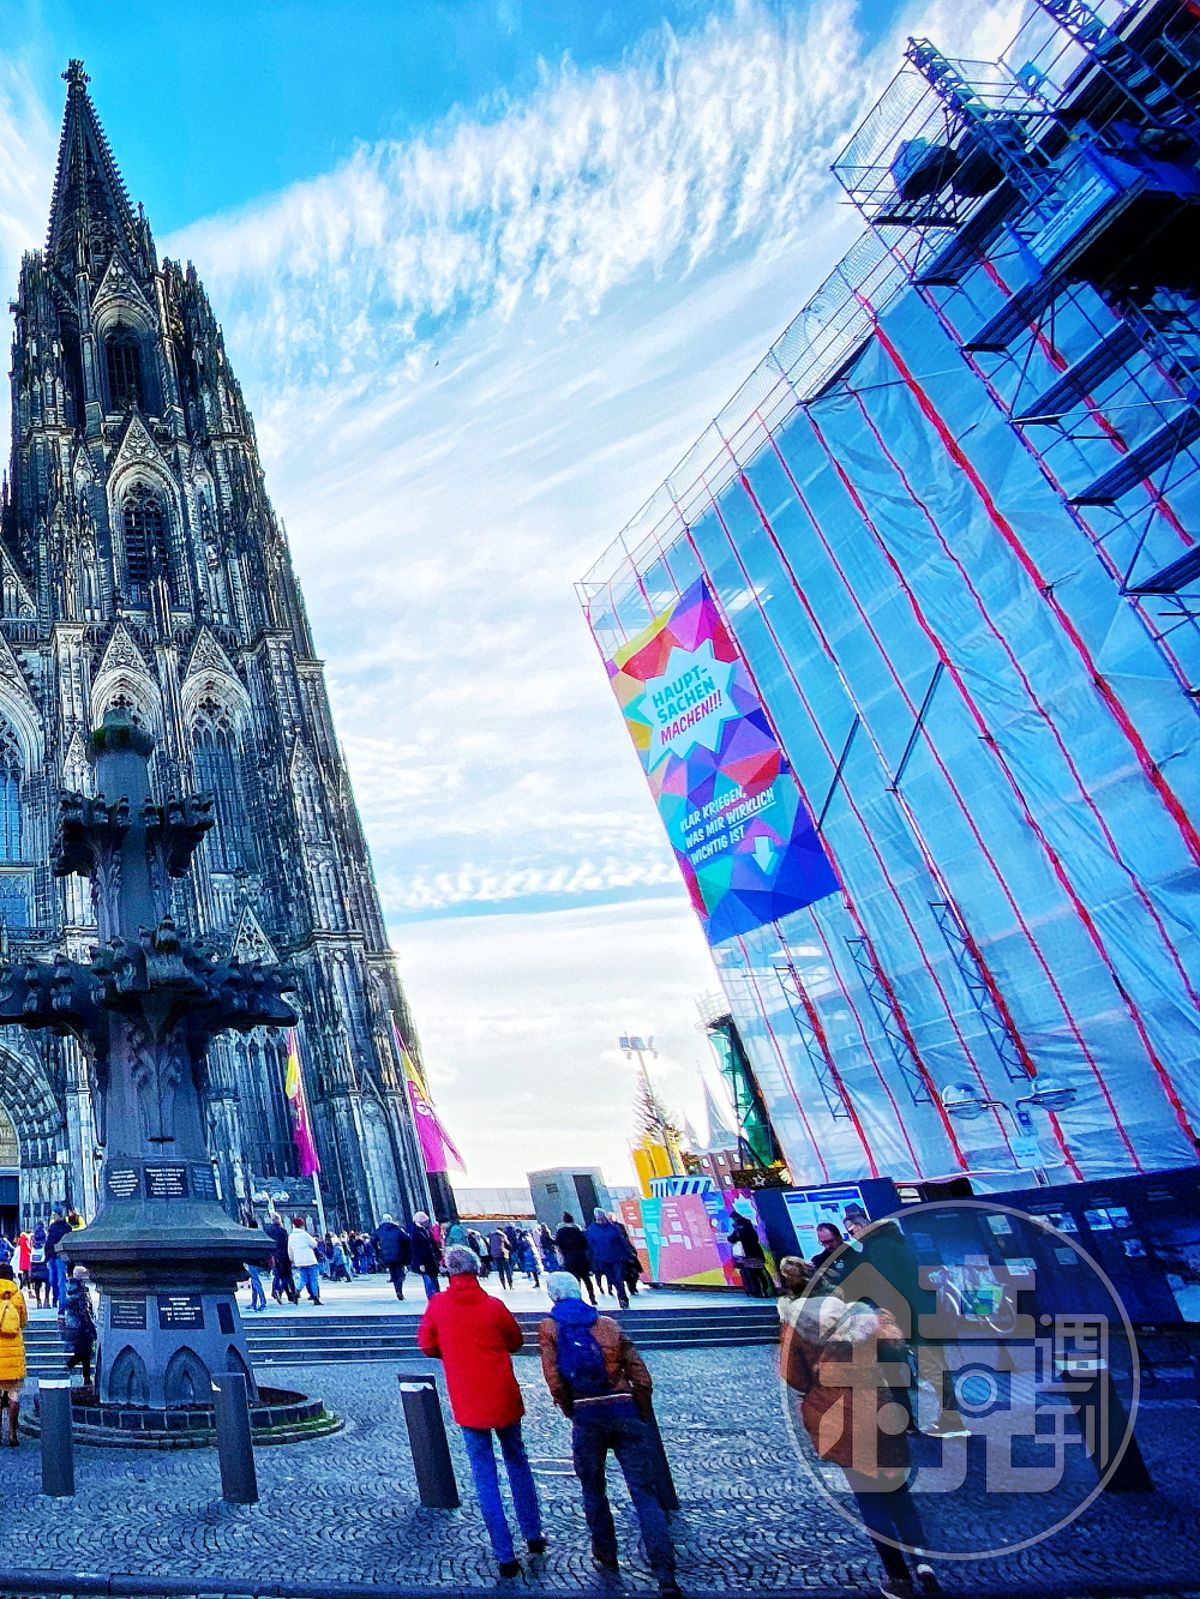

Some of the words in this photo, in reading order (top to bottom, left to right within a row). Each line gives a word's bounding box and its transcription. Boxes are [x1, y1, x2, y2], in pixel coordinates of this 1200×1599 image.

[652, 665, 707, 708] HAUPT-
[657, 676, 715, 724] SACHEN
[660, 689, 722, 745] MACHEN!!!
[685, 828, 704, 848] WAS
[705, 816, 725, 837] MIR
[725, 787, 775, 825] WIRKLICH
[690, 835, 728, 865] WICHTIG
[729, 824, 745, 844] IST
